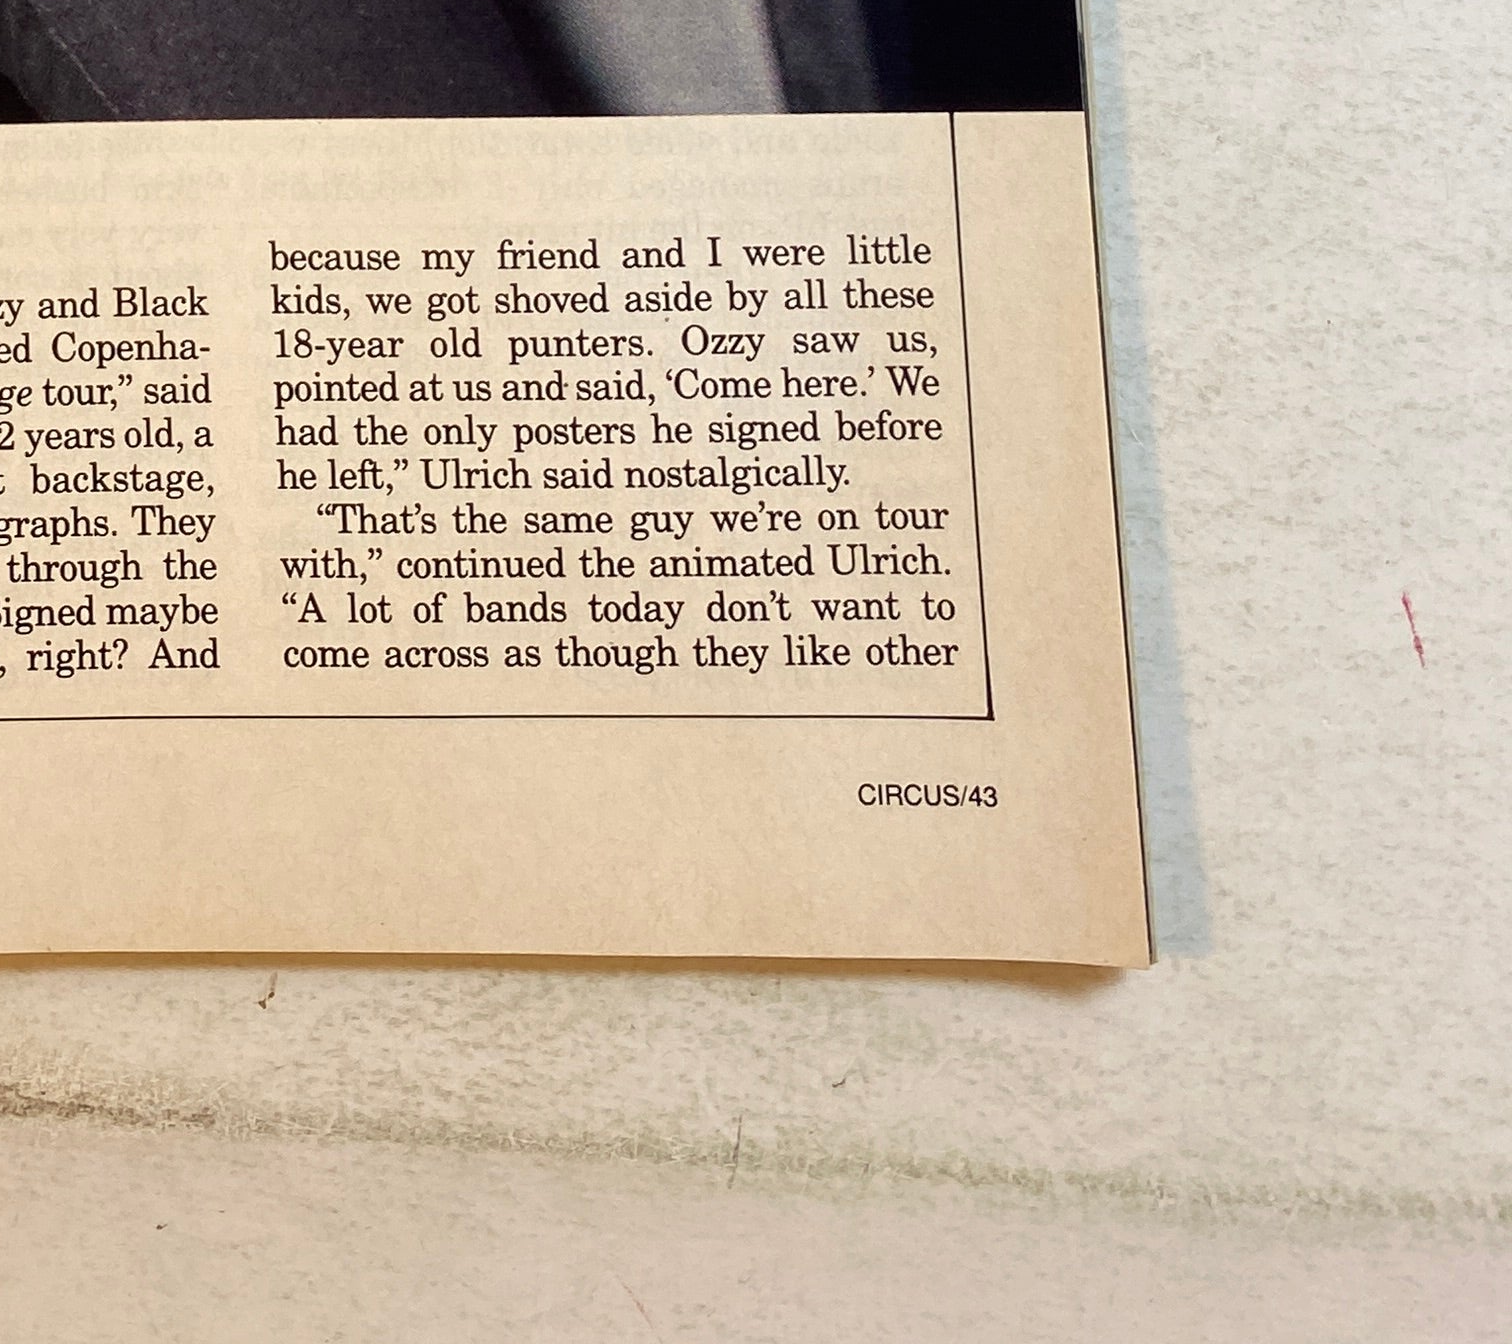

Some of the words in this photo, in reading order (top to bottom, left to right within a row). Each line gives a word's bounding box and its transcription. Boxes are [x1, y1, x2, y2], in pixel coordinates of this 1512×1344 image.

[267, 240, 401, 271] because
[420, 249, 476, 278] my
[496, 237, 601, 270] friend
[621, 236, 687, 269] and
[706, 236, 723, 268] I
[741, 244, 826, 267] were
[846, 232, 932, 265] little
[51, 329, 211, 370] Copenha-
[273, 328, 405, 366] 18-year
[430, 326, 483, 359] old
[507, 328, 654, 366] punters.
[681, 324, 766, 363] Ozzy
[792, 331, 861, 355] saw
[885, 331, 938, 359] us,
[41, 373, 133, 412] tour,”
[143, 372, 213, 405] said
[272, 370, 400, 410] pointed
[408, 372, 445, 402] at
[451, 380, 492, 402] us
[501, 369, 569, 402] and
[575, 368, 656, 407] said,
[665, 367, 772, 400] ‘Come
[779, 365, 875, 398] here.’
[884, 364, 940, 397] We
[23, 427, 116, 458] years
[123, 416, 184, 455] old,
[193, 426, 215, 448] a
[274, 414, 340, 447] had
[353, 414, 409, 446] the
[423, 413, 498, 453] only
[512, 416, 636, 454] posters
[649, 412, 693, 445] he
[708, 409, 822, 451] signed
[834, 408, 943, 442] before
[29, 461, 215, 500] backstage,
[275, 458, 317, 491] he
[326, 457, 409, 497] left,”
[418, 457, 533, 490] Ulrich
[542, 456, 615, 490] said
[623, 454, 850, 496] nostalgically.
[130, 504, 217, 544] They
[316, 502, 438, 535] “That’s
[451, 501, 508, 535] the
[524, 511, 614, 535] same
[630, 510, 695, 542] guy
[709, 500, 802, 533] we’re
[817, 508, 861, 531] on
[874, 500, 950, 531] tour
[279, 547, 383, 586] with,”
[396, 546, 567, 580] continued
[578, 546, 636, 579] the
[649, 543, 816, 578] animated
[826, 542, 951, 576] Ulrich.
[105, 592, 219, 633] maybe
[25, 637, 129, 679] right?
[147, 636, 221, 670] And
[283, 646, 370, 669] come
[384, 645, 490, 669] across
[503, 645, 542, 668] as
[554, 634, 680, 676] though
[691, 634, 770, 675] they
[782, 633, 851, 667] like
[865, 633, 960, 667] other
[857, 783, 999, 808] CIRCUS/43
